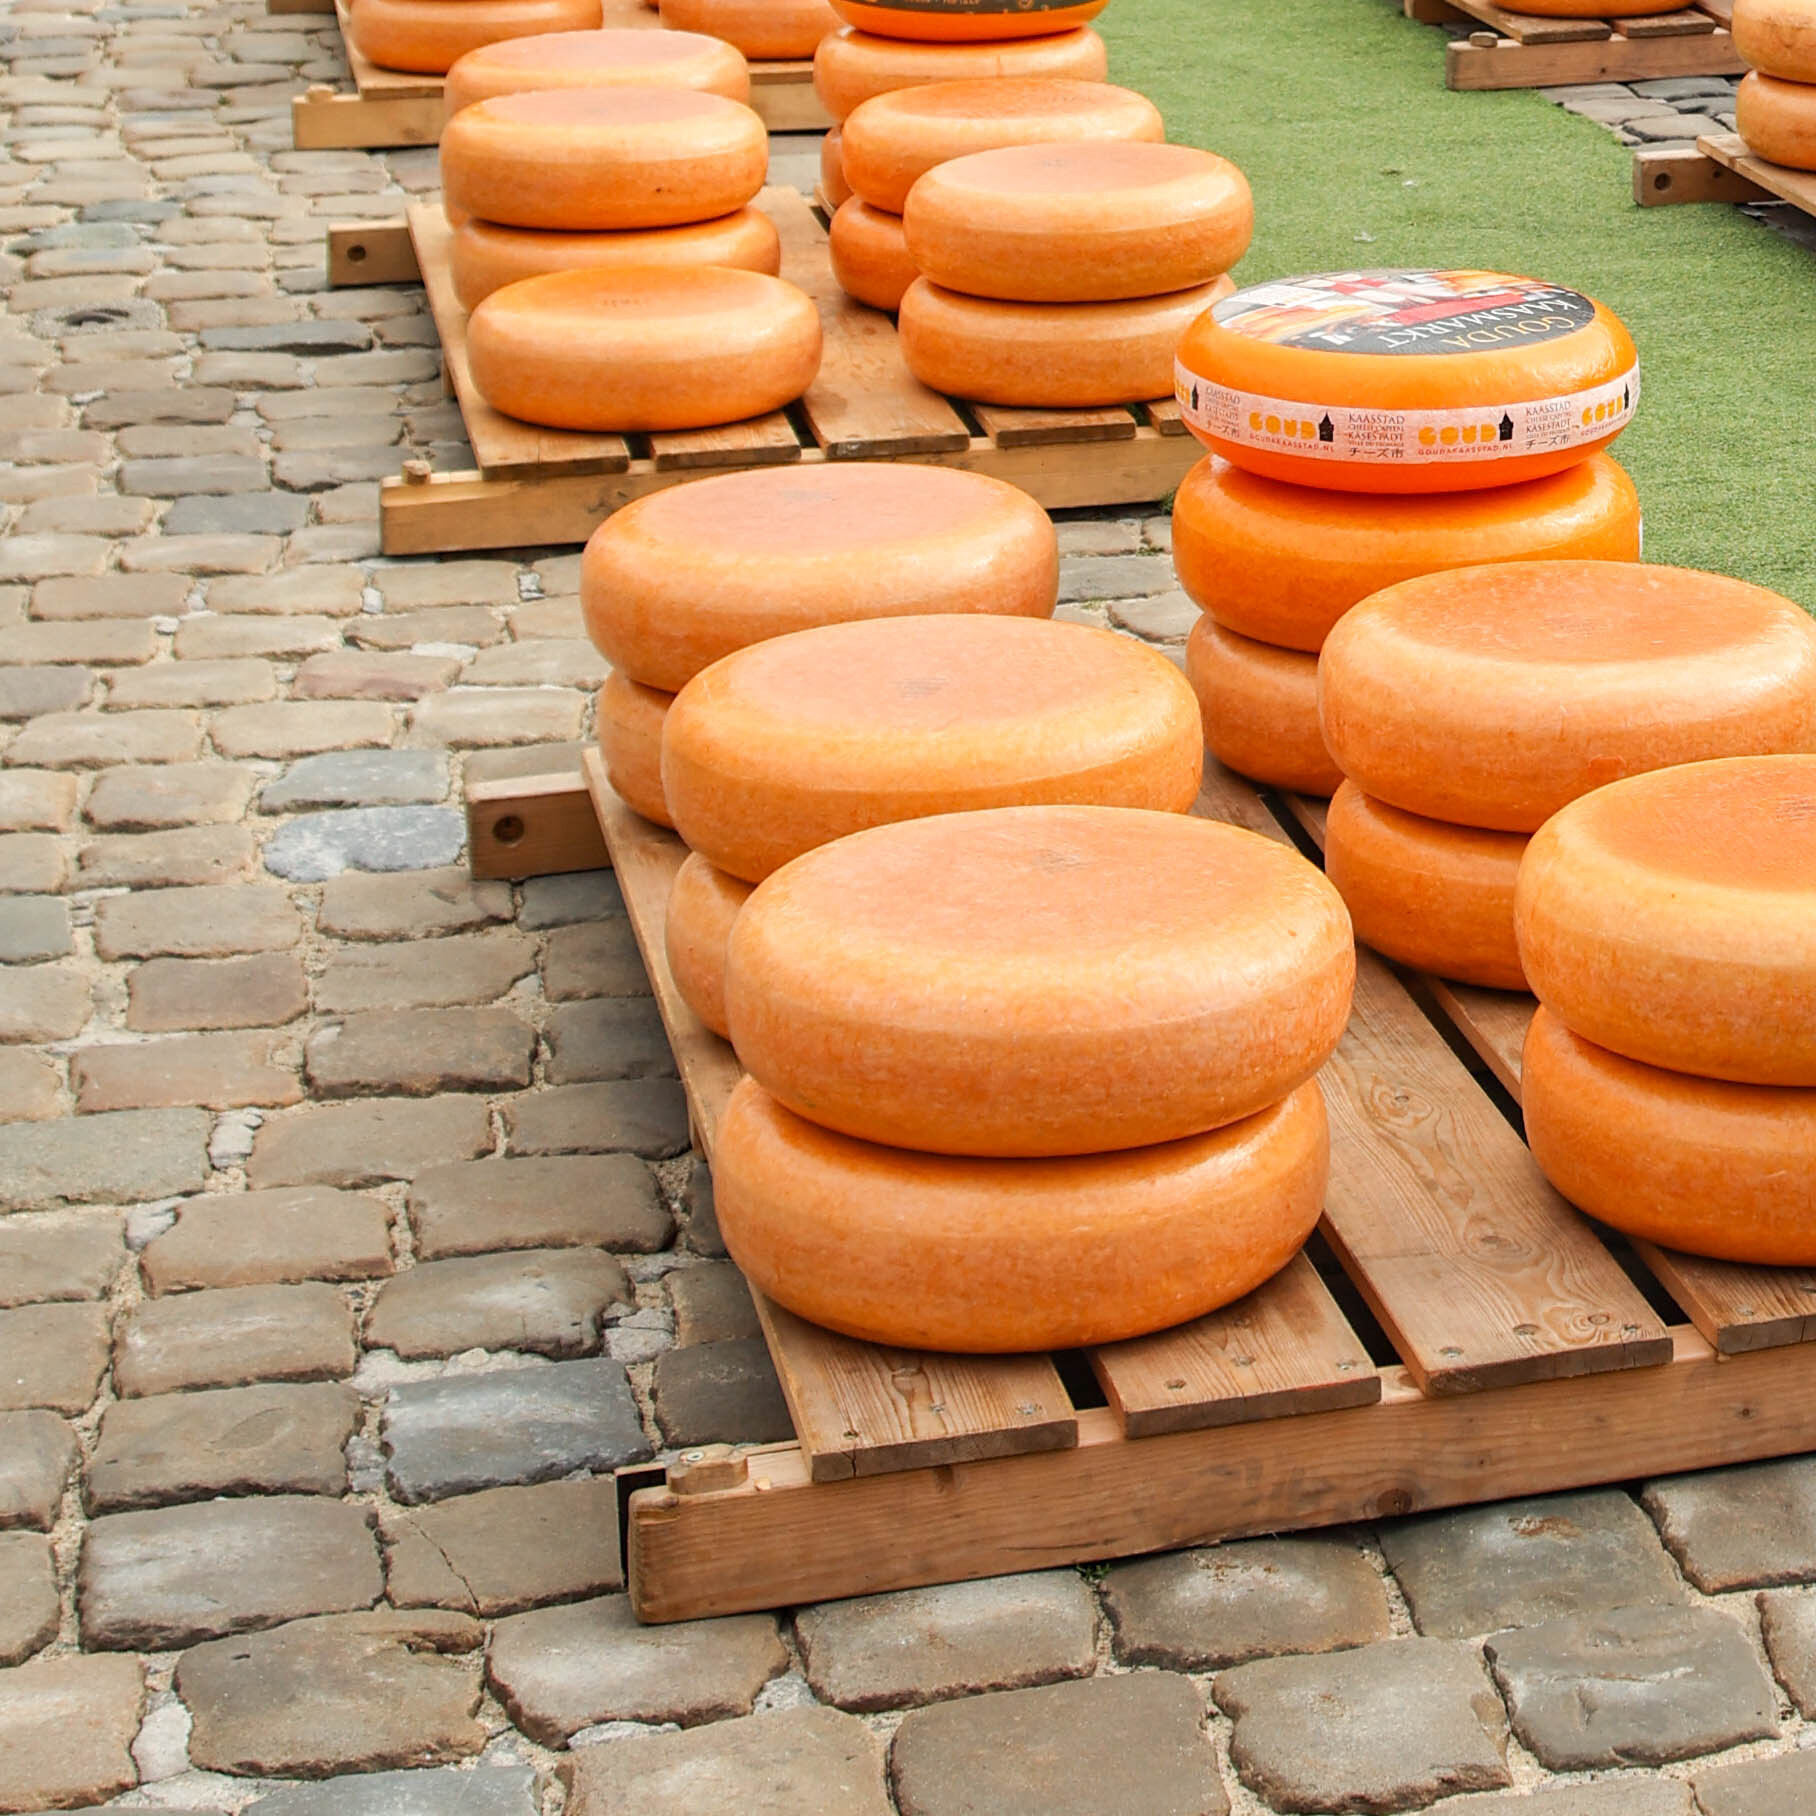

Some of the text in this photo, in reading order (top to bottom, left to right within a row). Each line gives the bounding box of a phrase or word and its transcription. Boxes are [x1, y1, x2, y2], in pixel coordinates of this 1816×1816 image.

[1378, 298, 1579, 349] KAASMARKT
[1440, 316, 1575, 348] GOUDA
[1348, 412, 1406, 425] KAASSTAD
[1526, 400, 1571, 417] KAASSTAD
